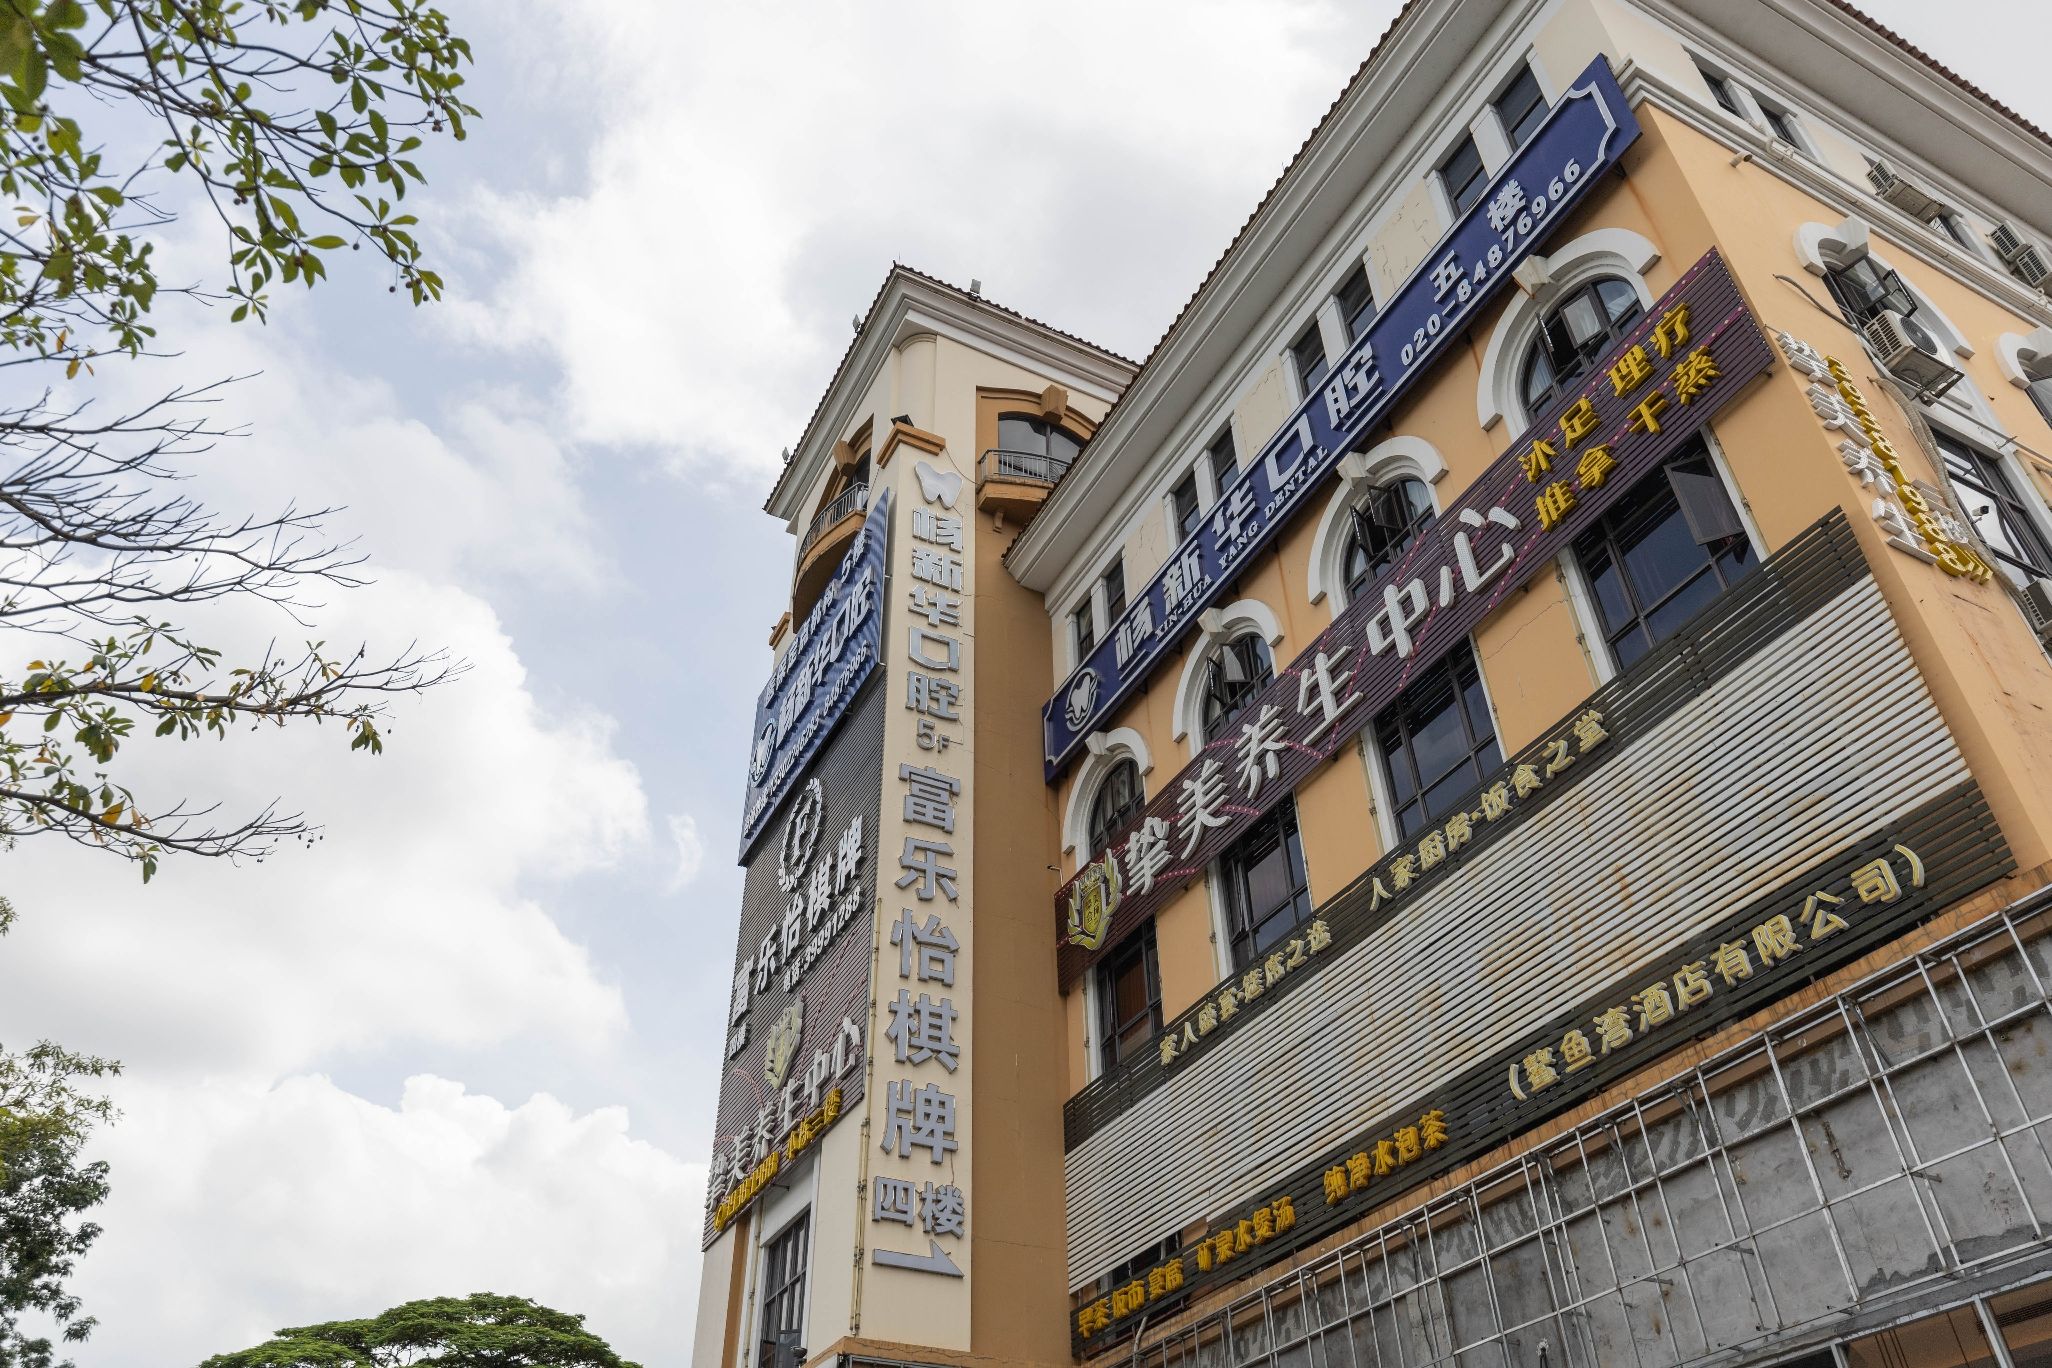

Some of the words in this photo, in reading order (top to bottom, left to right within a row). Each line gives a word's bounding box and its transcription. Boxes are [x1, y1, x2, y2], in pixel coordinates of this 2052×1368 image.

[1401, 158, 1580, 366] 020-84876966
[1115, 342, 1381, 669] 杨新华口腔
[1430, 179, 1527, 302] 五楼
[1518, 397, 1602, 484] 沐足
[1607, 303, 1690, 397] 理疗
[1536, 443, 1617, 532] 推拿
[1627, 346, 1722, 434] 干蒸
[1823, 355, 1967, 577] 39381988
[841, 527, 868, 584] 5楼
[907, 507, 963, 721] 杨新华口腔
[1155, 577, 1213, 641] XIN-HUA
[1219, 520, 1260, 569] YANG
[1264, 446, 1328, 519] DENTAL
[777, 564, 872, 747] 杨新华口腔
[916, 719, 950, 754] 5F
[1125, 506, 1522, 896] 挚美养生中心
[732, 814, 864, 1024] 富乐怡棋牌
[880, 762, 961, 1164] 富乐怡棋牌
[706, 1016, 862, 1211] 挚美养生中心
[872, 1175, 965, 1239] 四楼
